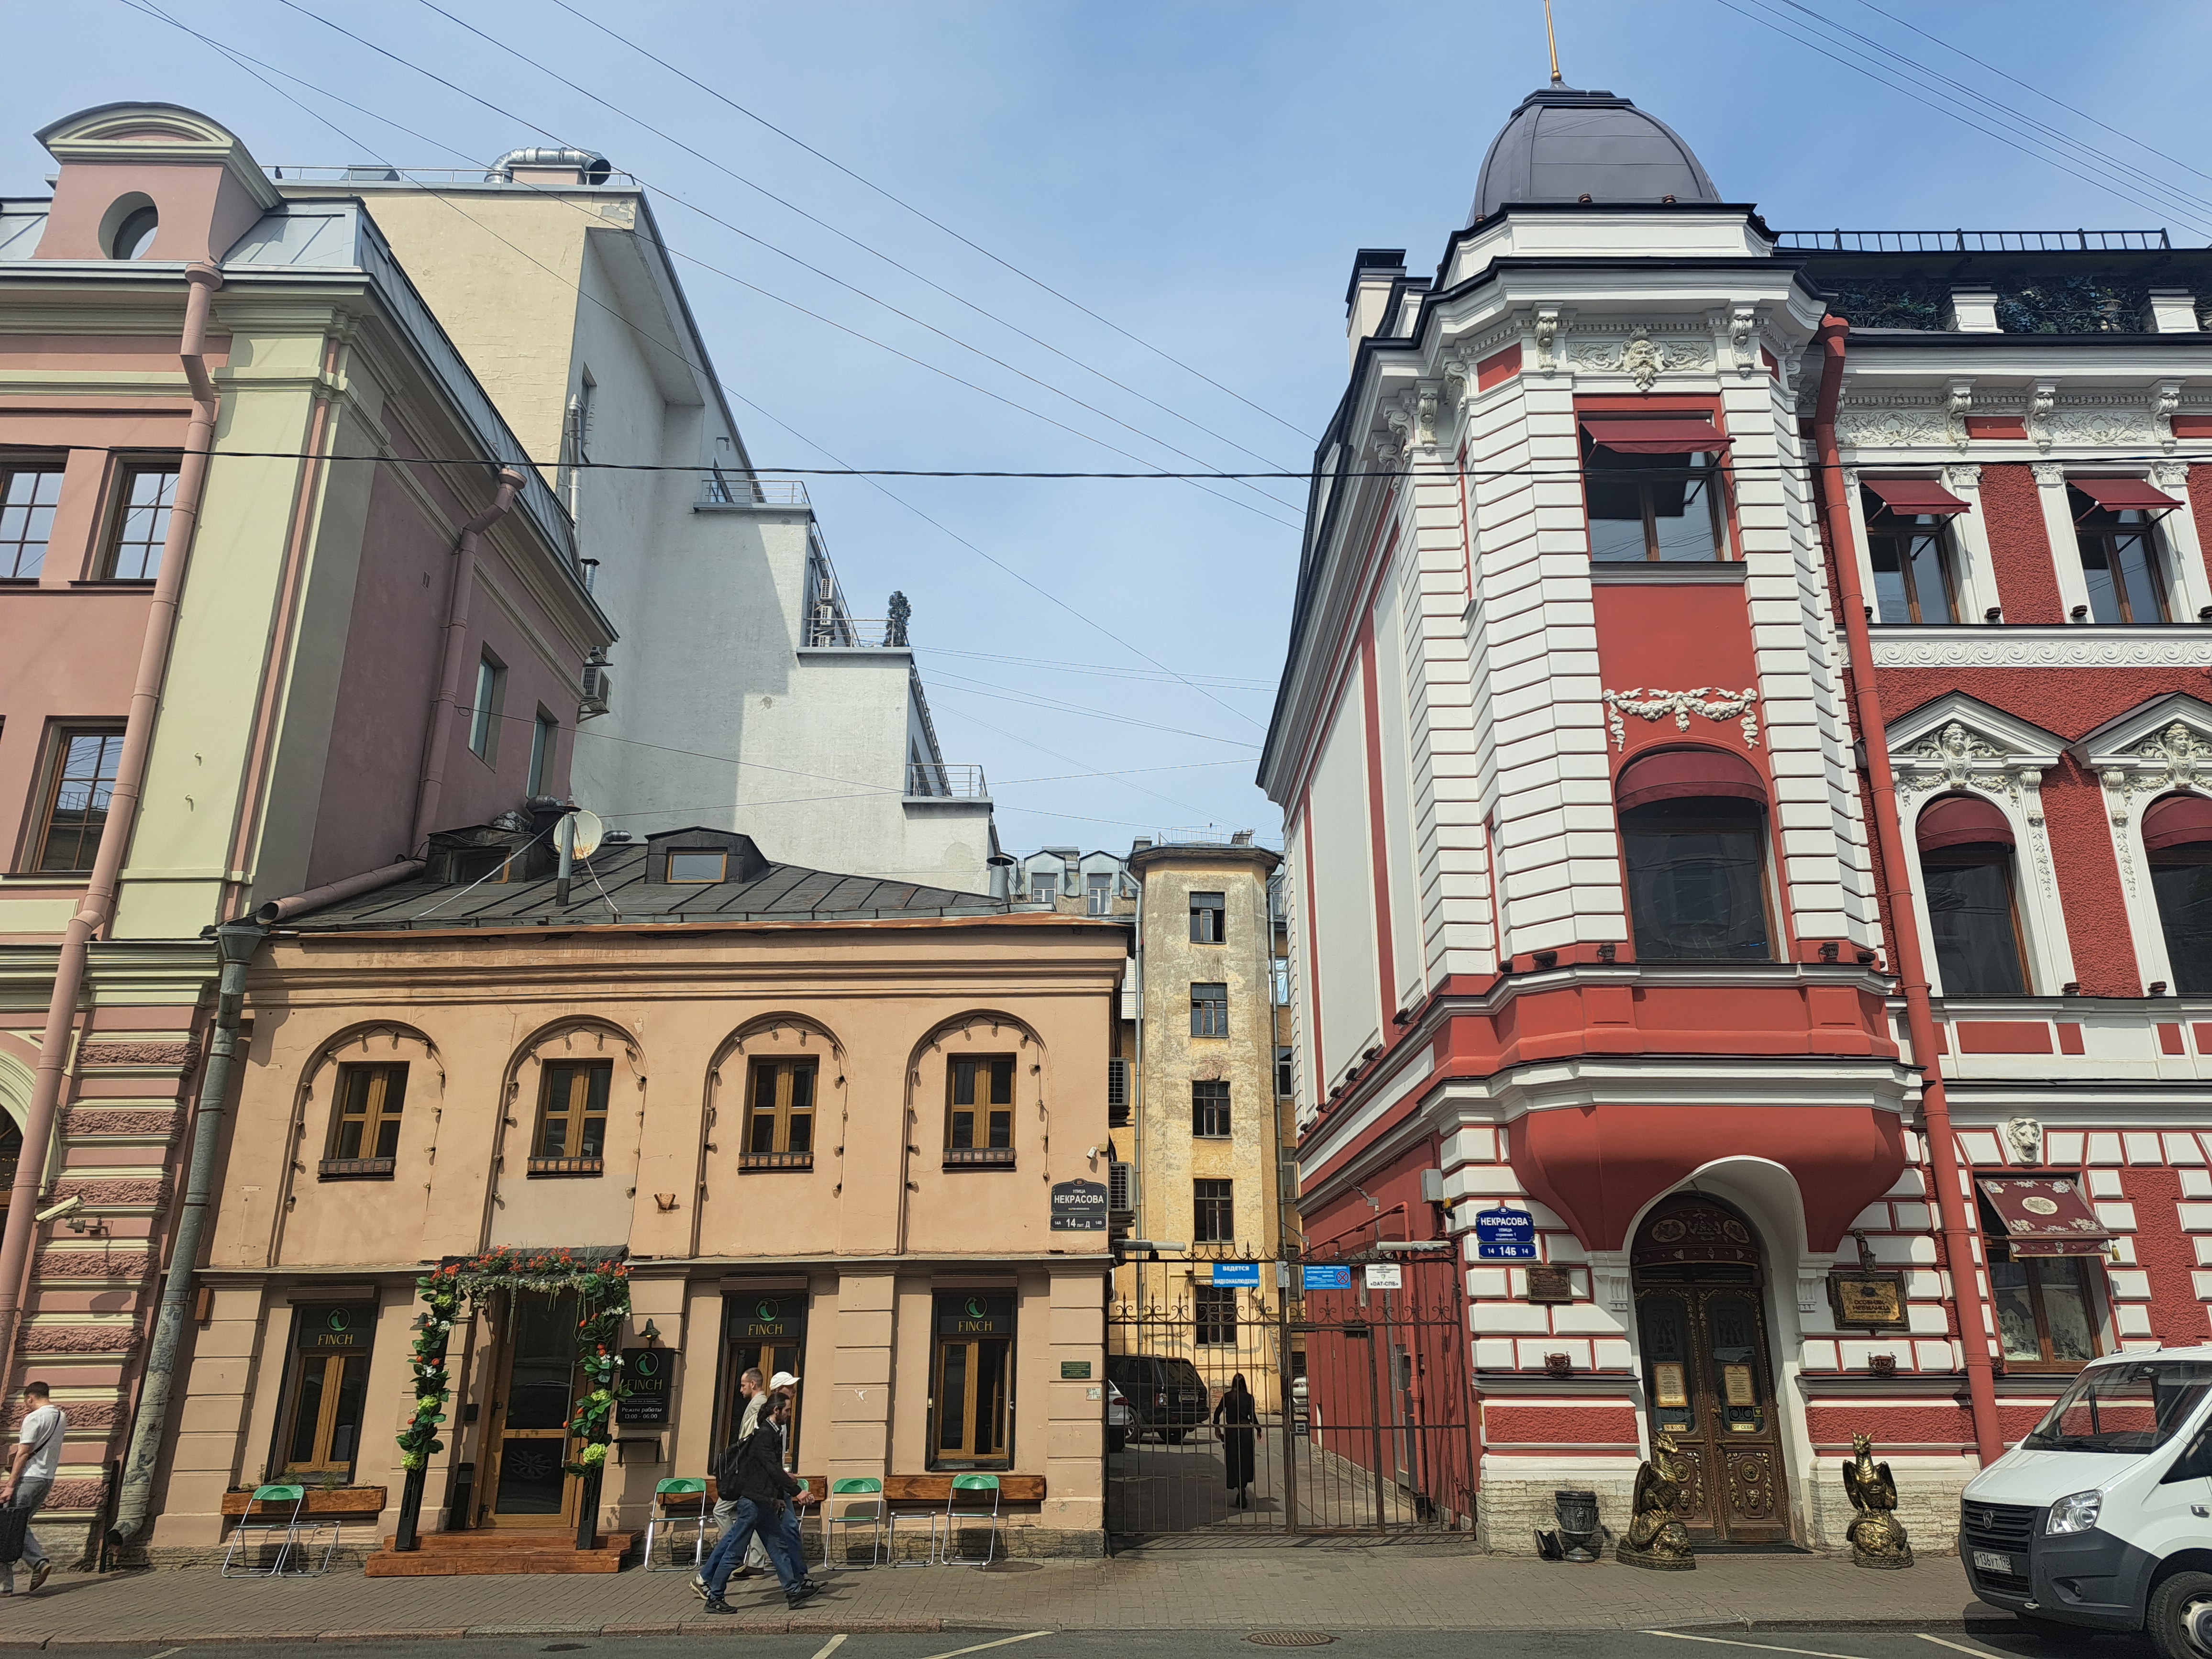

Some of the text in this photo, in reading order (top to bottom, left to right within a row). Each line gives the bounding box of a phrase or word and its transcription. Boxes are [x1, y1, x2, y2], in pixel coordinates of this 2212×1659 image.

[1054, 1195, 1104, 1204] НЕКРАСОВА
[1066, 1218, 1076, 1228] 14
[1481, 1217, 1528, 1226] НЕКРАСОВА
[748, 1324, 783, 1335] FINCH
[958, 1321, 993, 1332] FINCH
[317, 1334, 353, 1345] FINCH
[627, 1379, 663, 1390] FINCH
